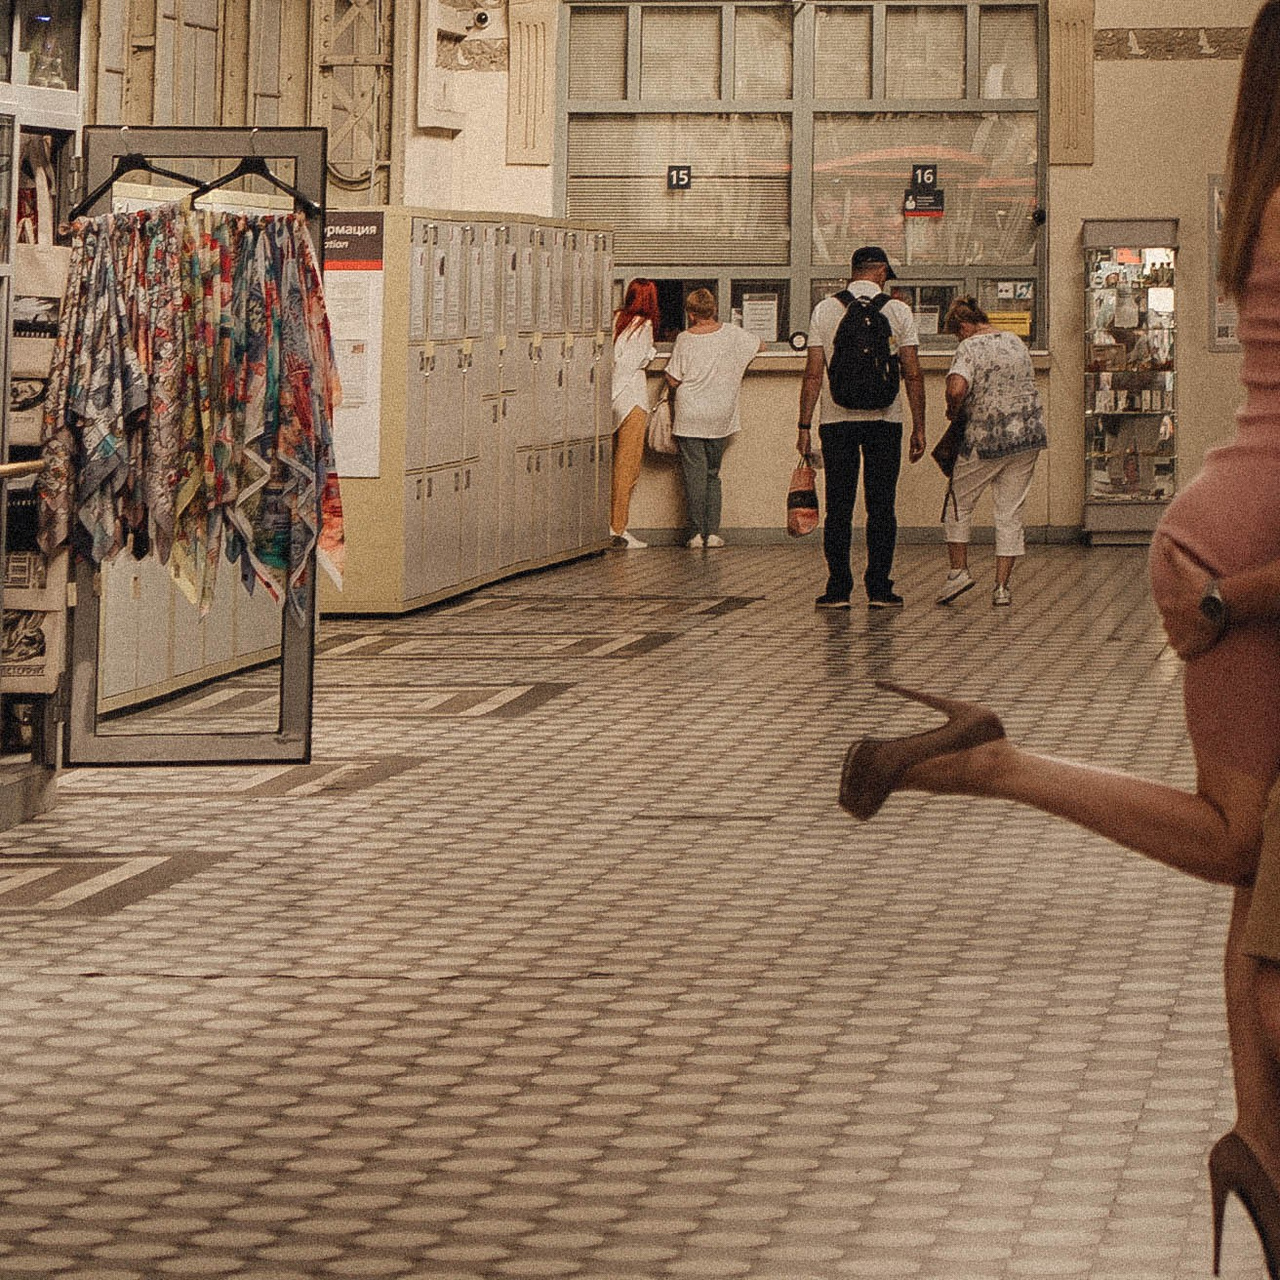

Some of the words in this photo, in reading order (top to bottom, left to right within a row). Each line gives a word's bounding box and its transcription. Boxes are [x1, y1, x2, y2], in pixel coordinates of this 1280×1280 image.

[670, 170, 688, 185] 15
[915, 169, 933, 183] 16
[324, 225, 377, 237] рмация
